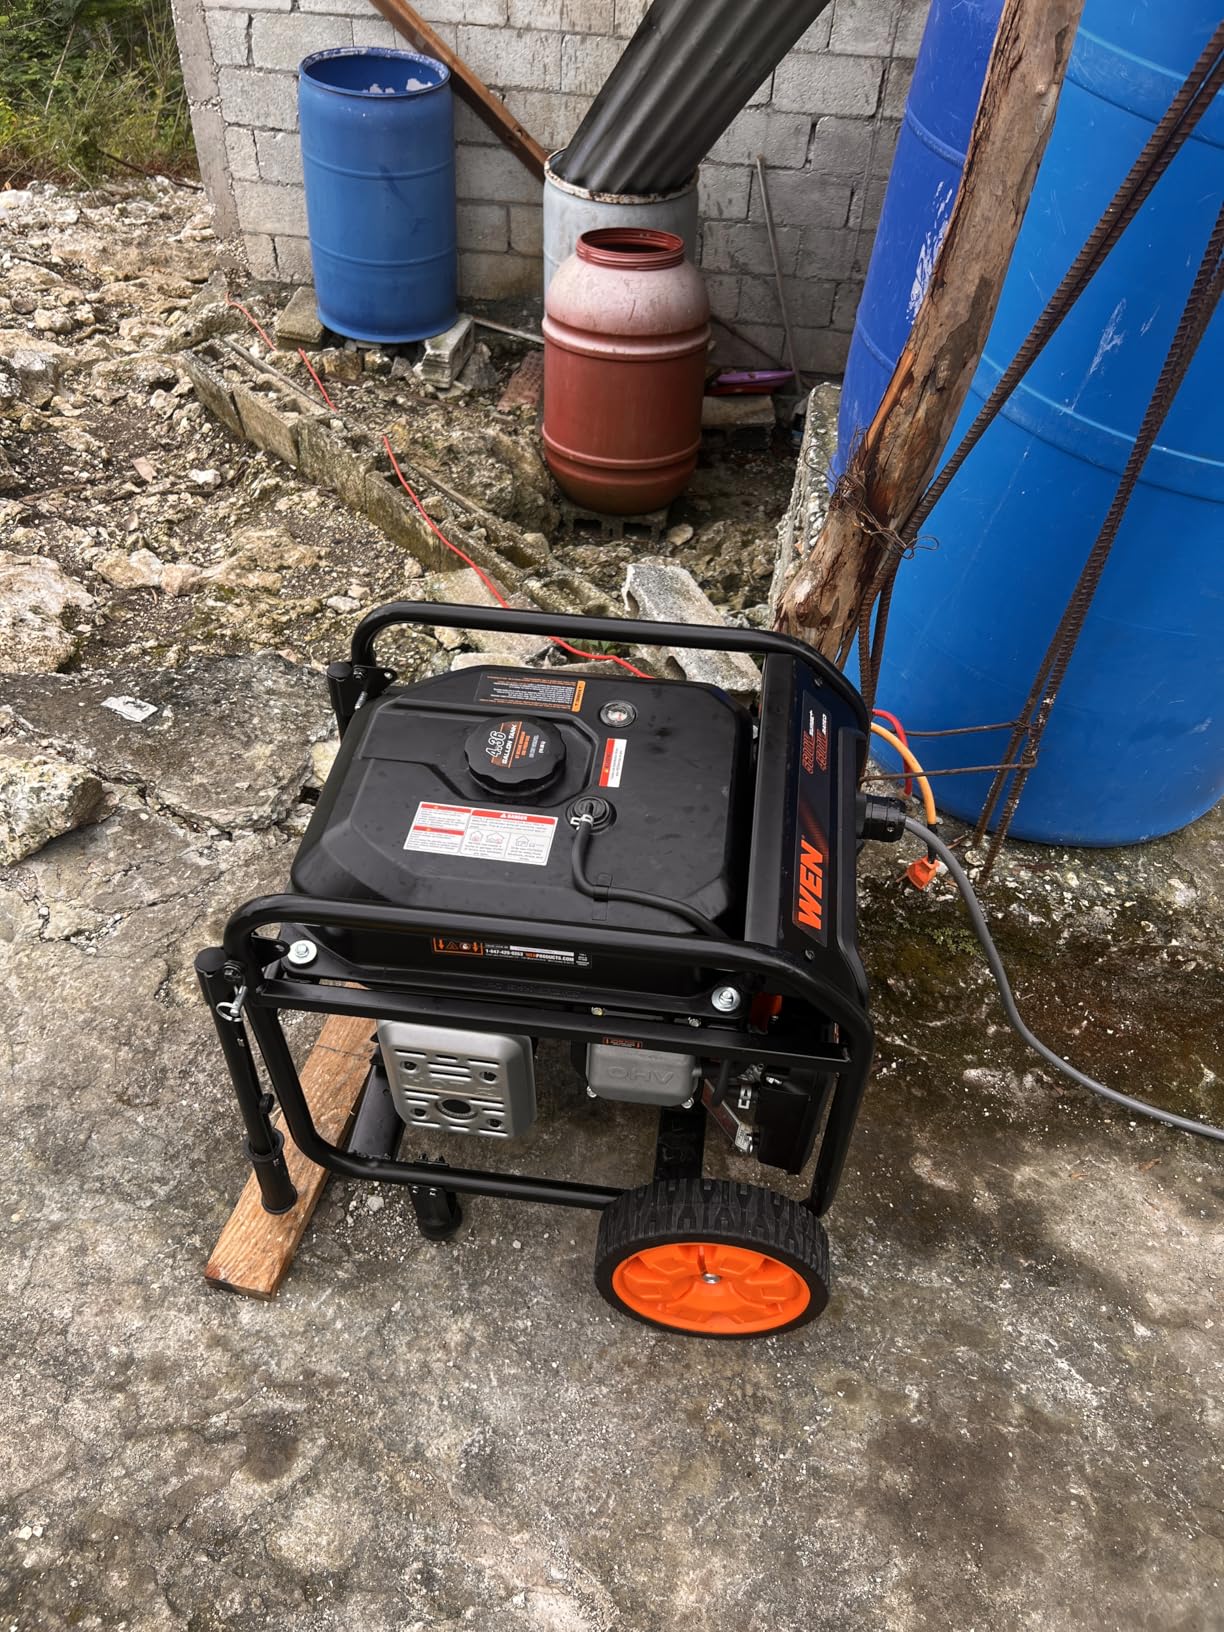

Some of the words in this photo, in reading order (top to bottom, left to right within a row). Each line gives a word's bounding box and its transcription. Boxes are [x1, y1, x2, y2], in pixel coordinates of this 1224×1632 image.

[485, 730, 507, 758] 4.36
[501, 740, 513, 765] GALLON
[508, 723, 517, 740] TANK
[798, 839, 823, 930] WEN
[607, 1065, 675, 1085] OHV
